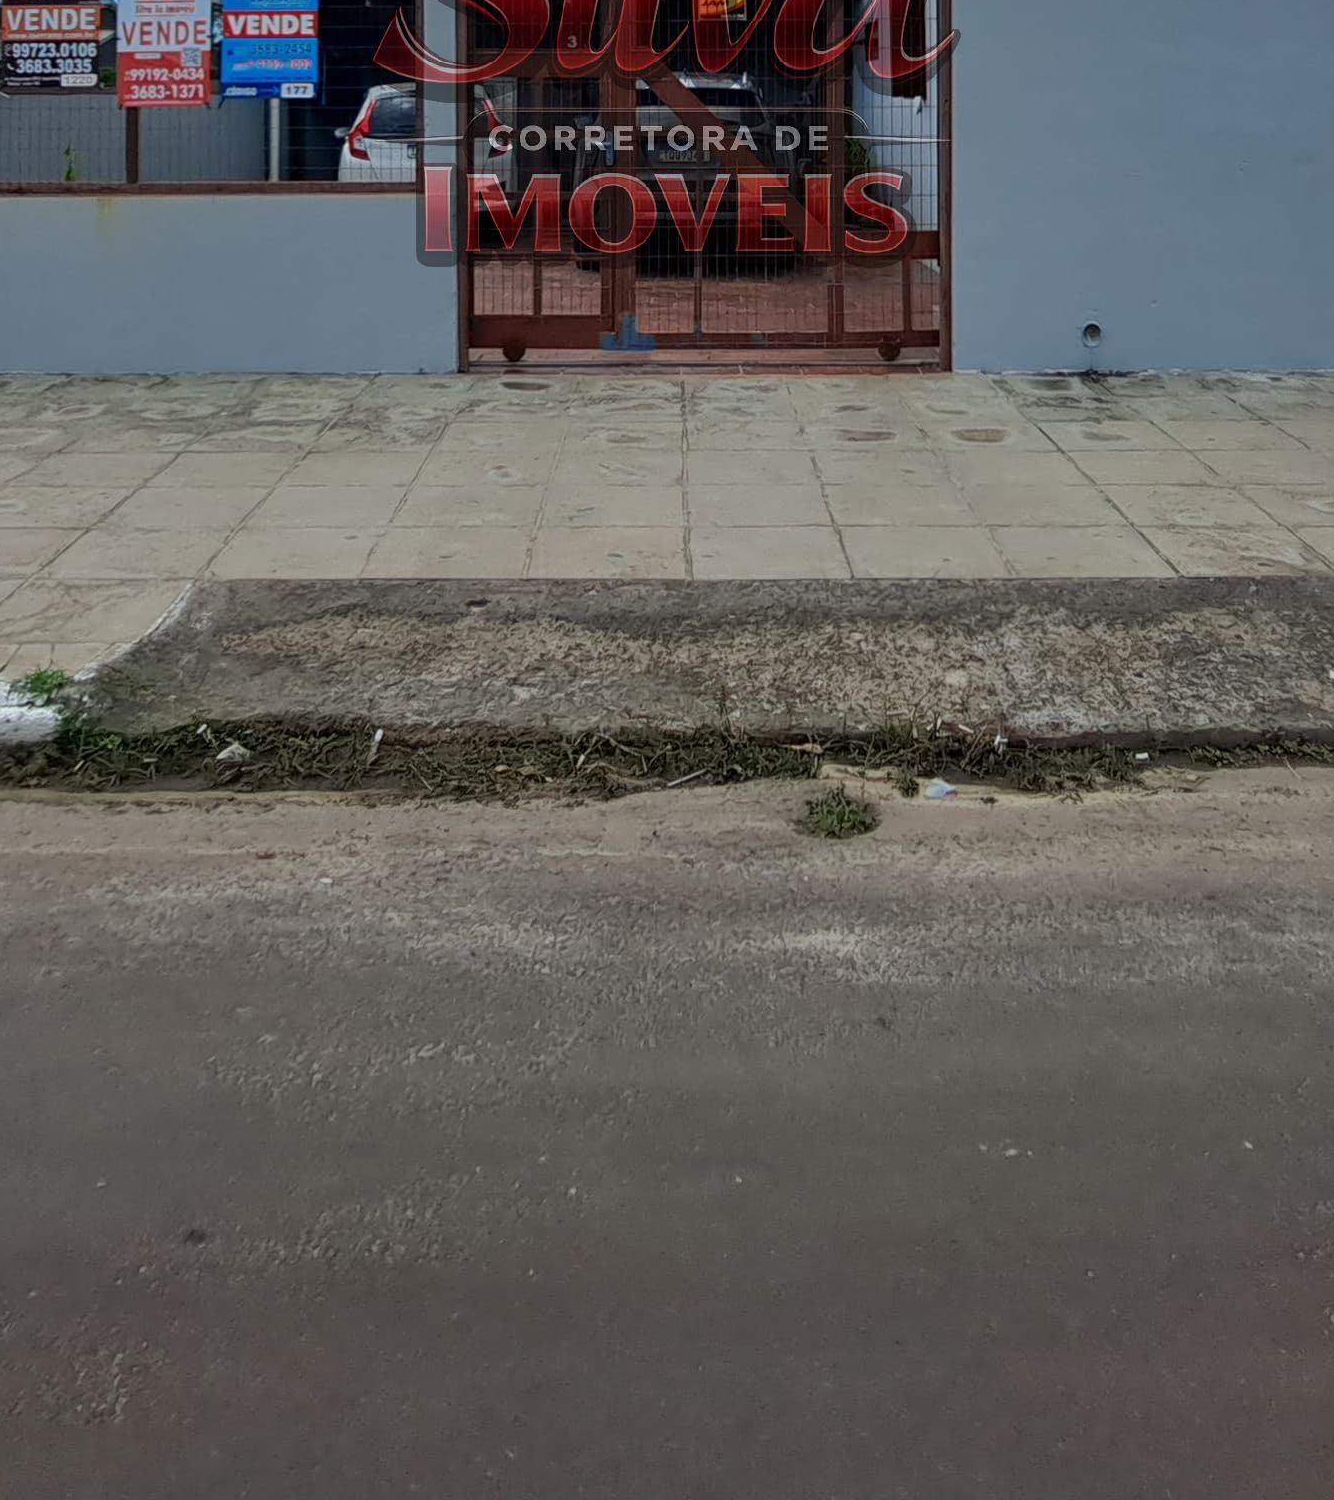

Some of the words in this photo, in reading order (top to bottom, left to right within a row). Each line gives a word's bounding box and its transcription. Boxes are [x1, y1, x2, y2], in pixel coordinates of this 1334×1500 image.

[7, 9, 97, 30] VENDE
[227, 14, 315, 35] VENDE
[122, 20, 207, 46] VENDE
[566, 35, 578, 48] 3
[11, 43, 97, 57] 99723.0106
[16, 59, 92, 73] 3683.3035
[130, 84, 205, 100] 3683-1371
[285, 86, 308, 95] 177
